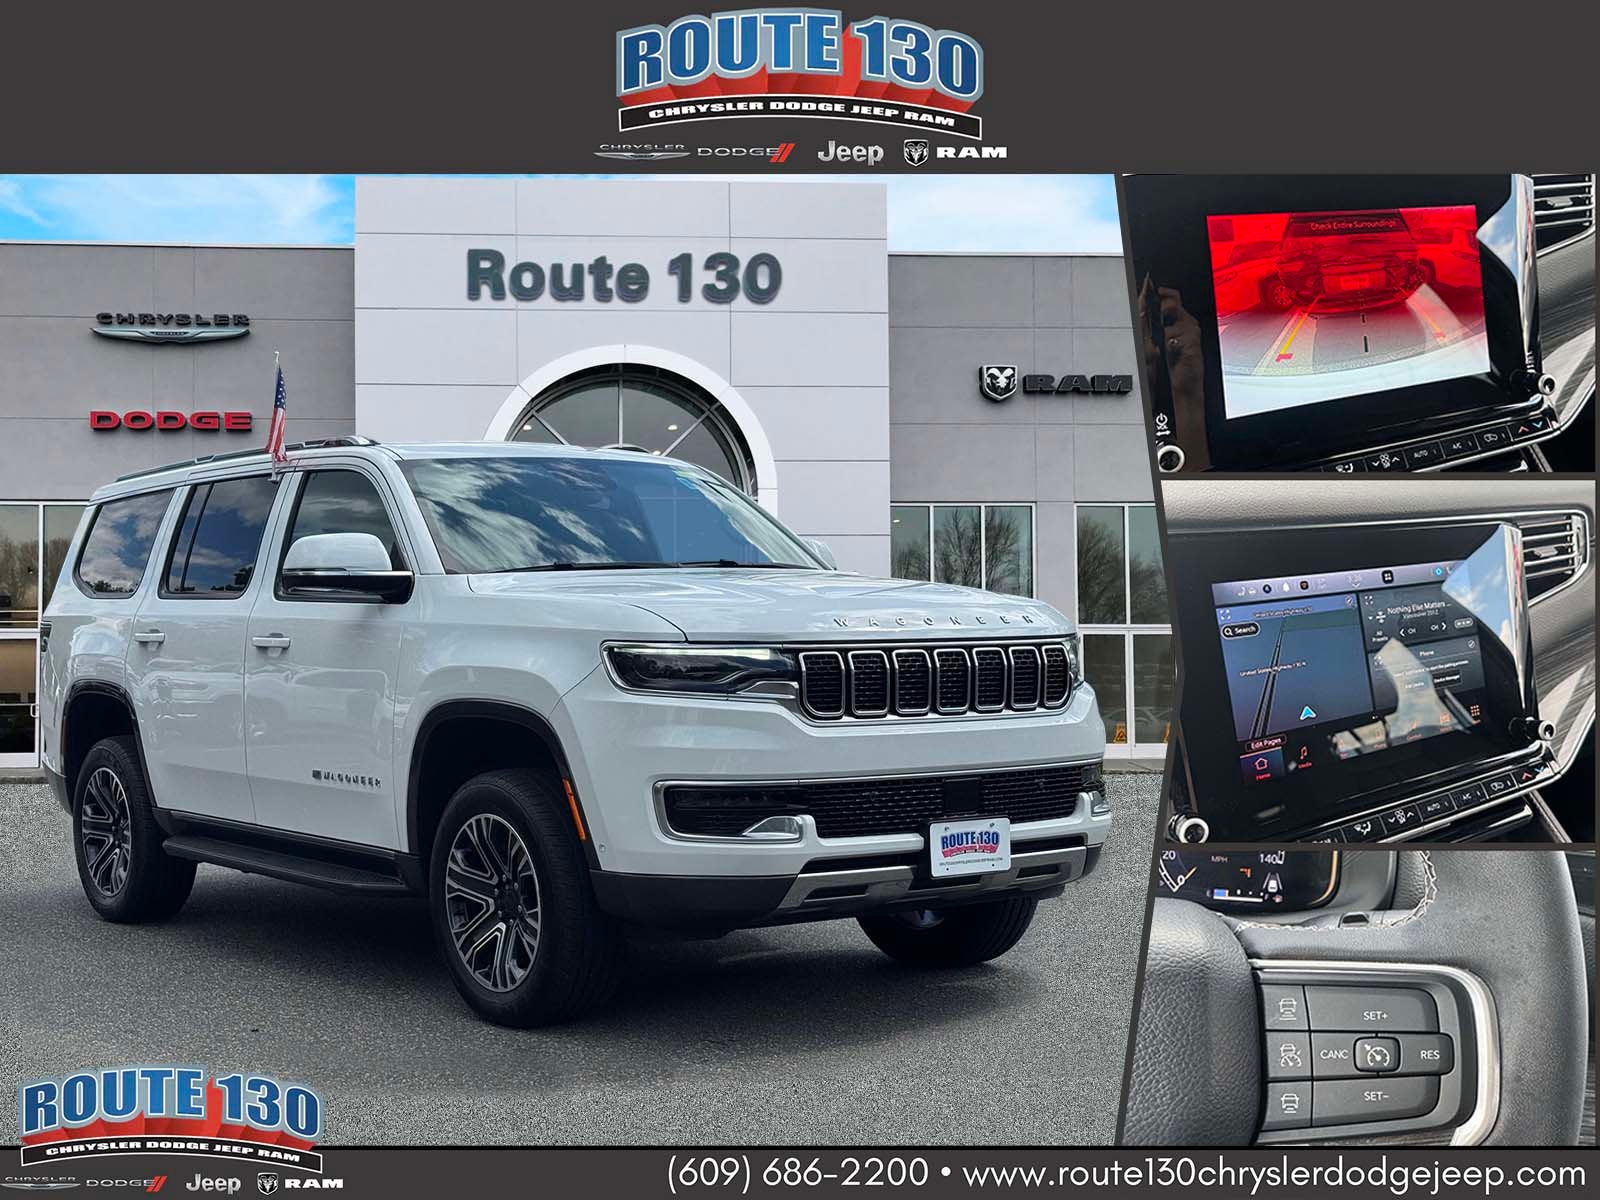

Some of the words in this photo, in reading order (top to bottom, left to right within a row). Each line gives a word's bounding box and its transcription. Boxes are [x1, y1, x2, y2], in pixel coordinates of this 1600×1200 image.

[1310, 222, 1332, 231] Check
[1333, 221, 1353, 230] Entire
[467, 248, 650, 303] Route
[668, 251, 783, 305] 130
[96, 312, 250, 327] CHRYSLER
[1023, 374, 1133, 394] RAM
[89, 410, 252, 433] DODGE
[1413, 450, 1429, 459] AUTO
[1386, 604, 1412, 615] Nothing
[833, 616, 1034, 628] WAGONEER
[1234, 625, 1257, 635] Search
[1250, 741, 1264, 750] Edit
[1263, 737, 1283, 749] Pages
[1426, 802, 1441, 812] AUTO
[941, 831, 977, 850] ROUTE
[979, 831, 1000, 846] 130
[1162, 850, 1176, 860] 20
[1211, 855, 1228, 863] MPH
[1363, 1010, 1388, 1021] SET+
[1319, 1048, 1349, 1060] CANC
[1420, 1048, 1440, 1060] RES
